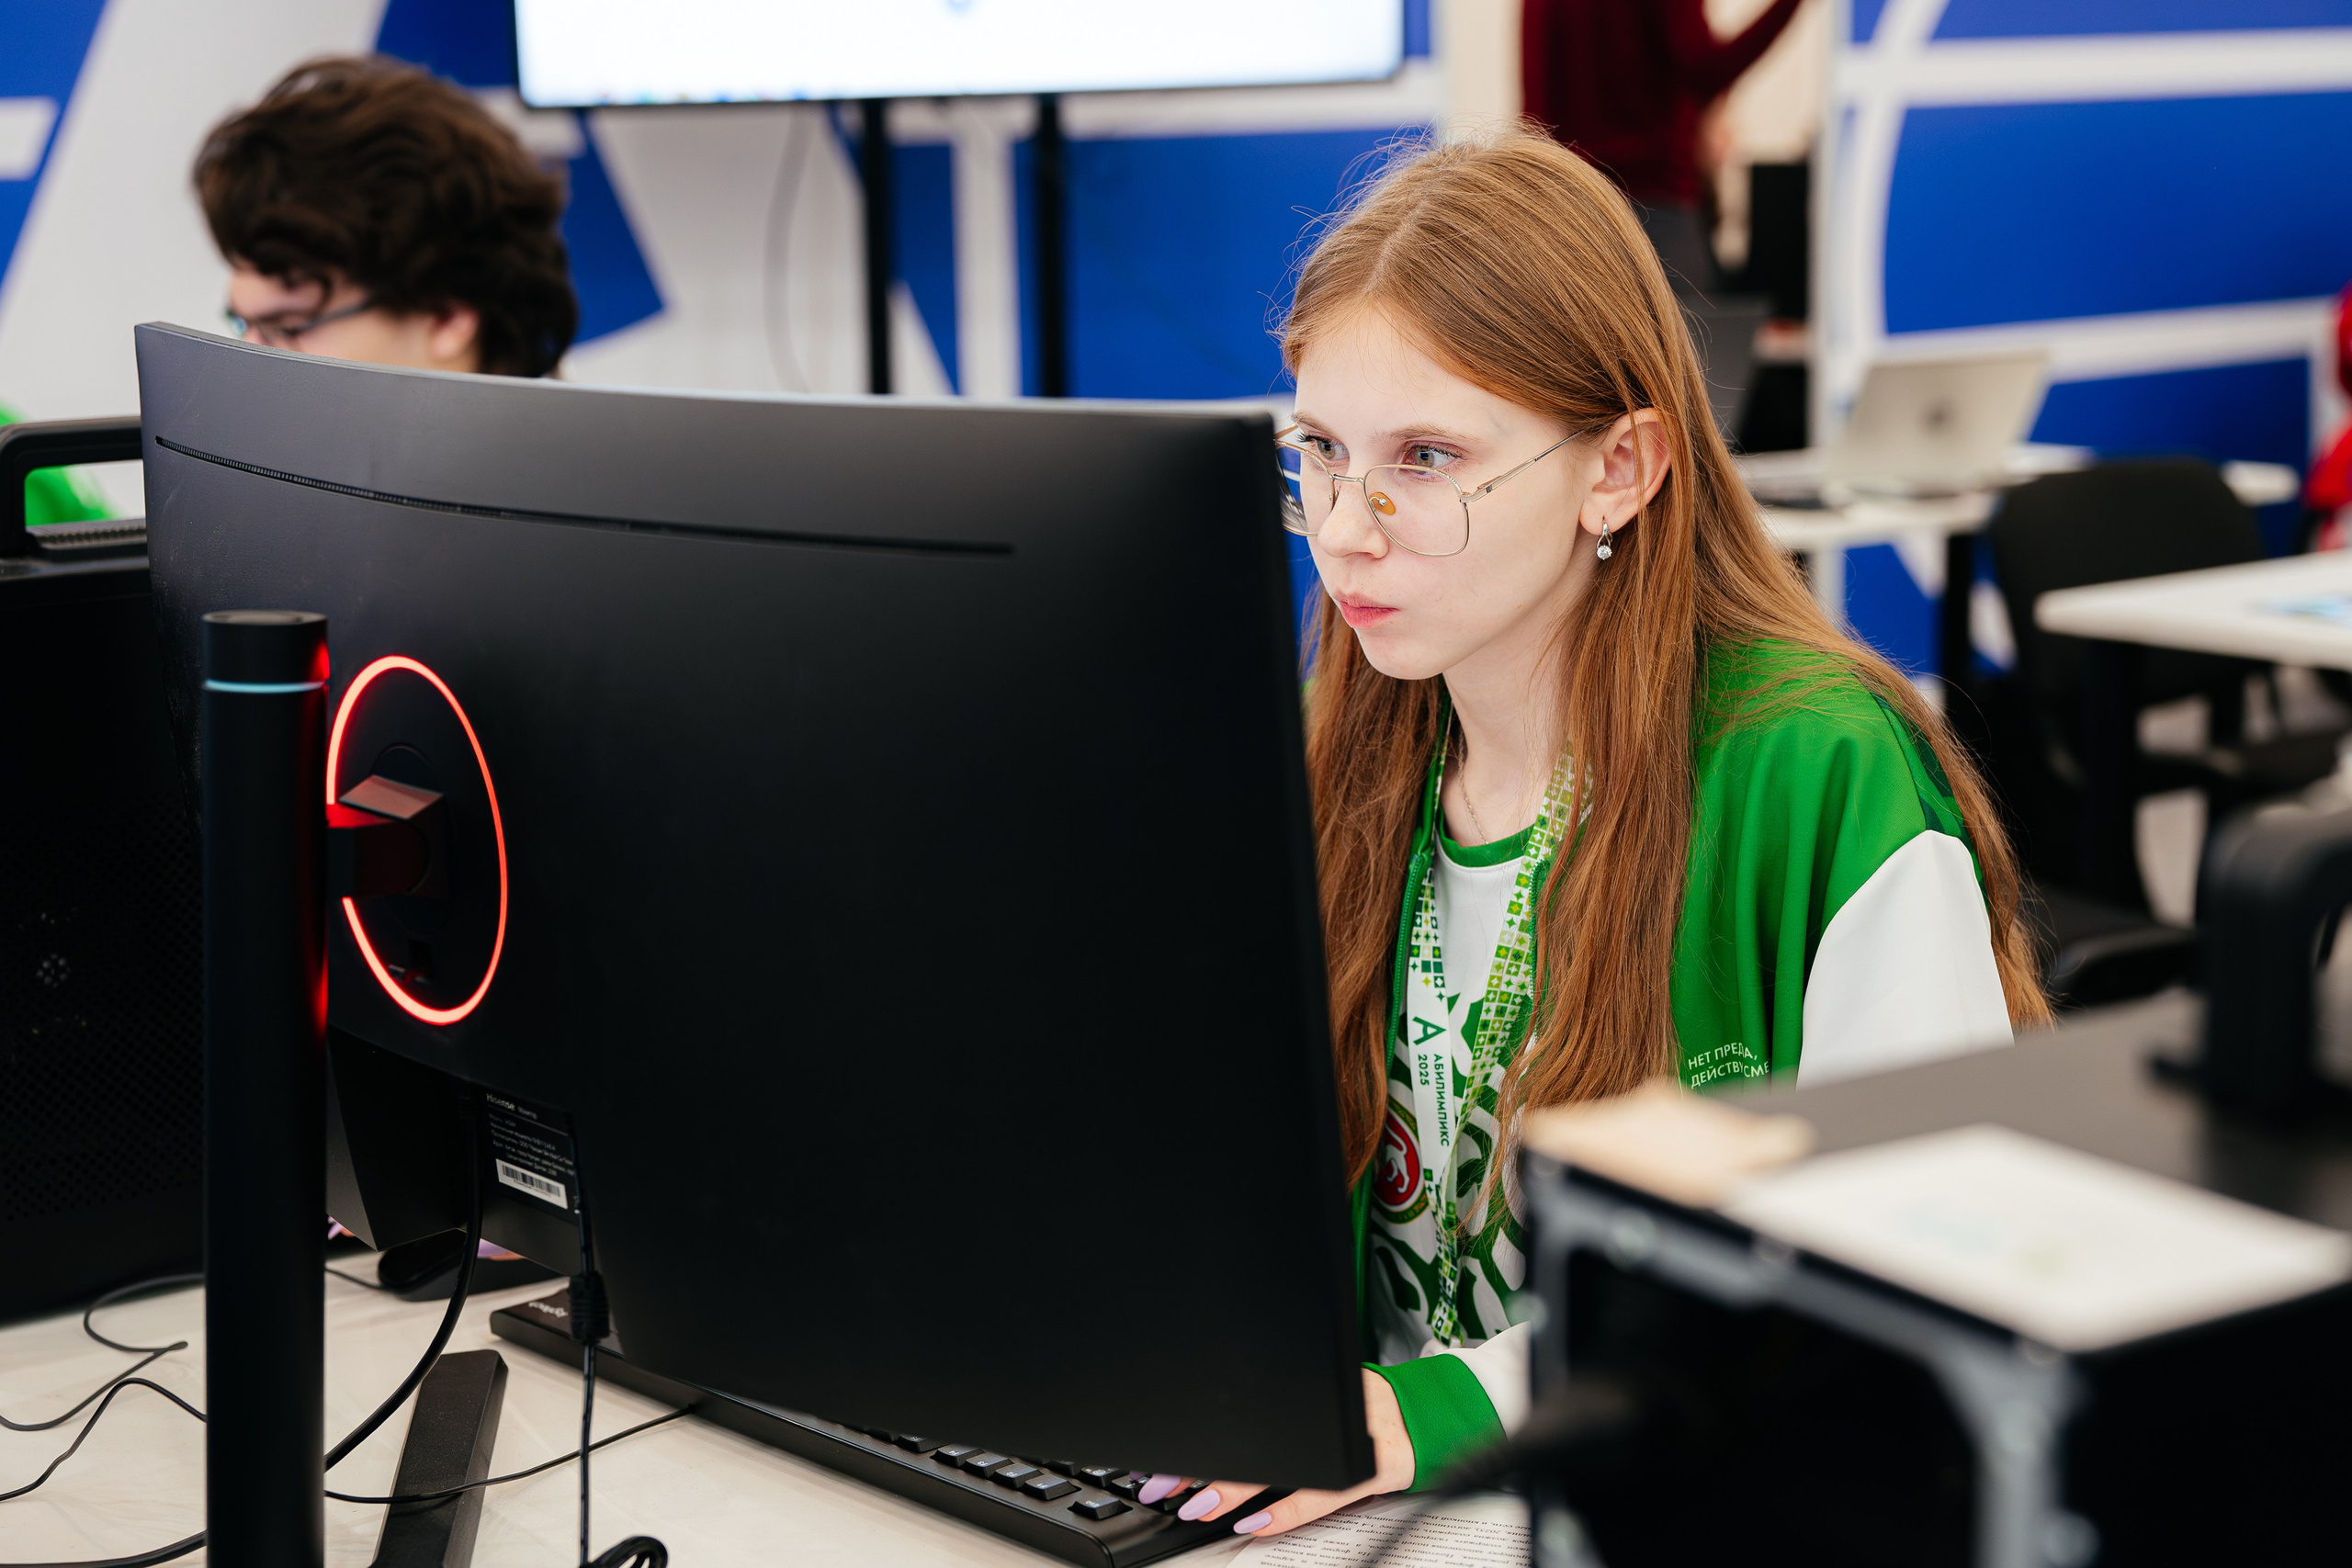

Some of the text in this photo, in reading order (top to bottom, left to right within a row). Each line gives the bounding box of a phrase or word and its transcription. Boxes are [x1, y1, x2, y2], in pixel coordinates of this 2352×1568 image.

[1412, 1016, 1447, 1046] А
[1418, 1054, 1430, 1086] 2025
[1688, 1051, 1711, 1070] НЕТ
[1433, 1054, 1450, 1147] АБИЛИМПИКС
